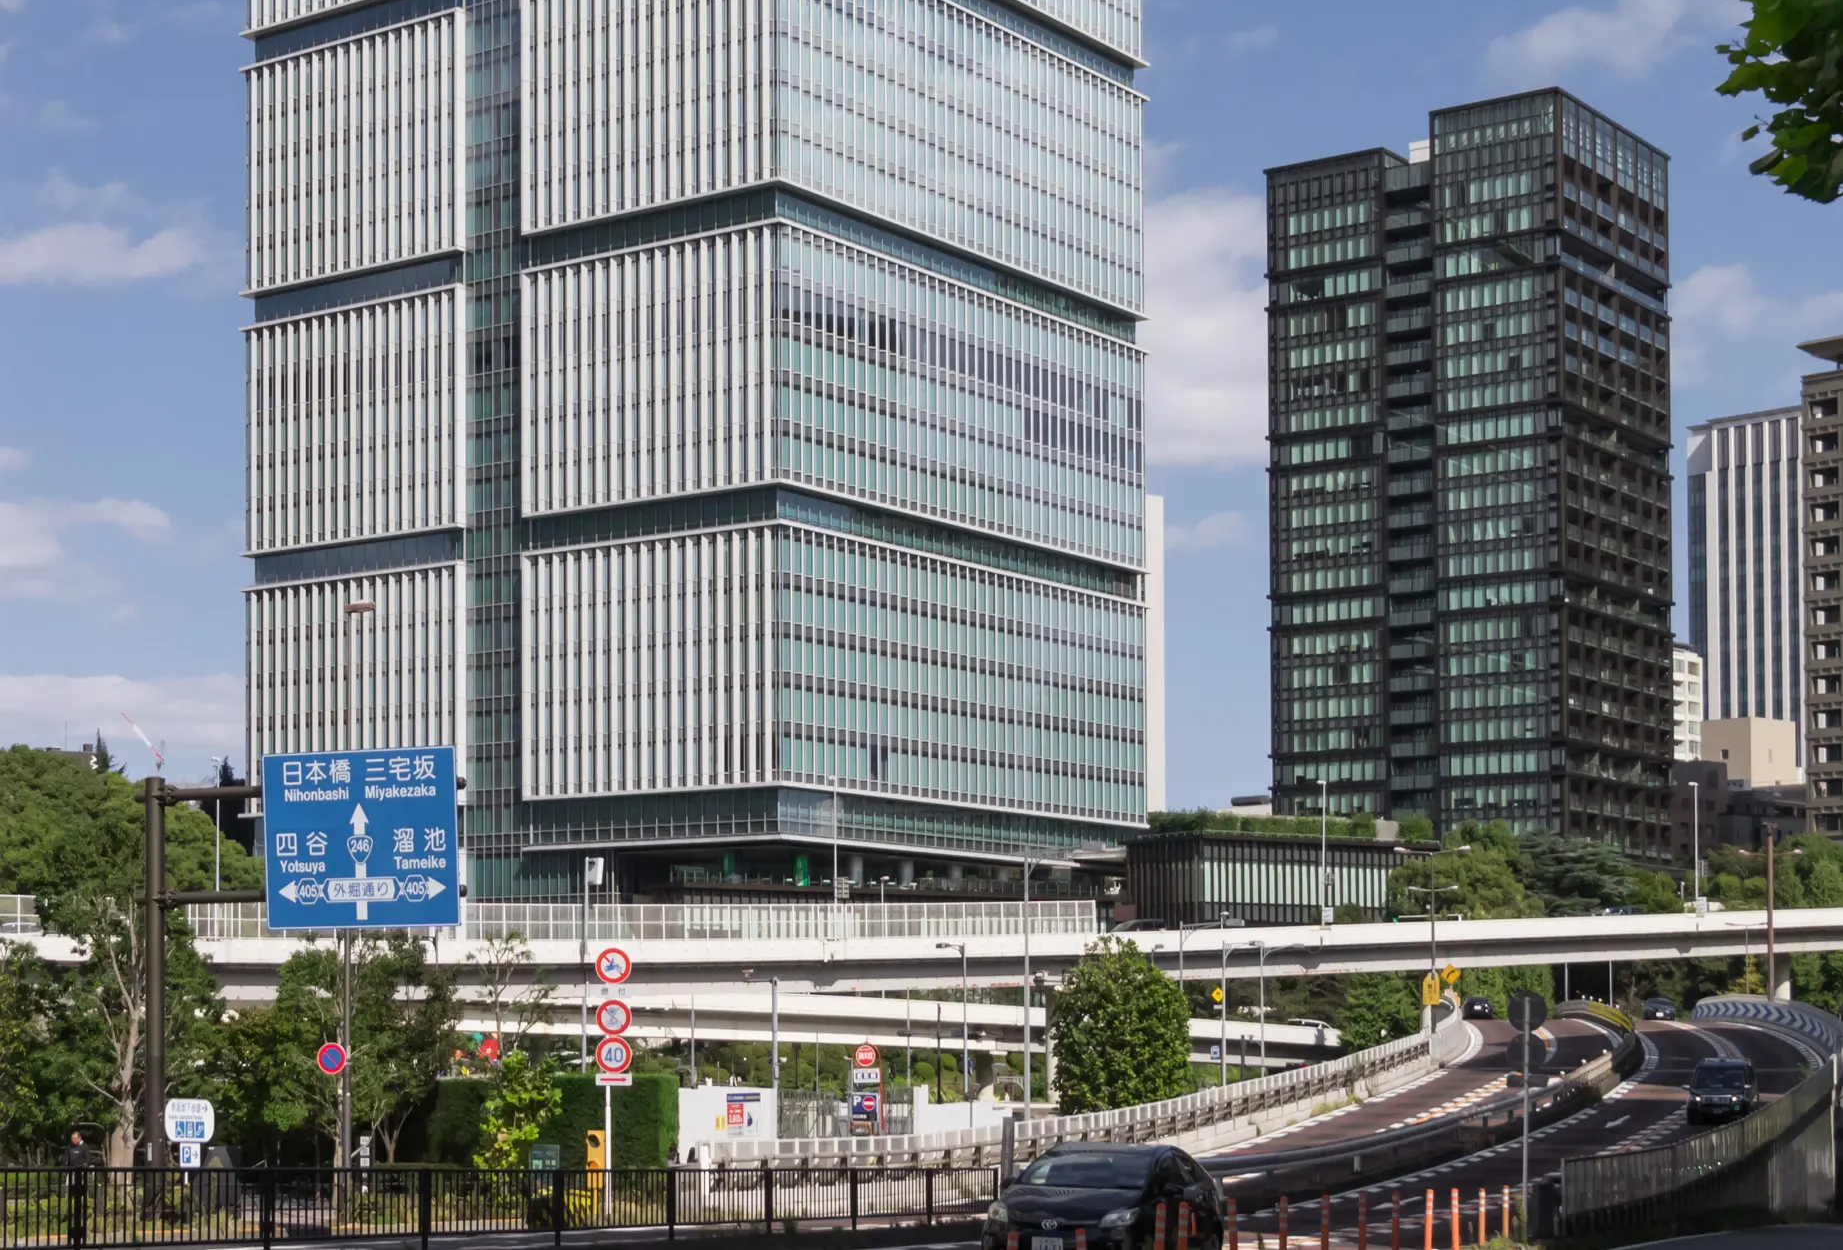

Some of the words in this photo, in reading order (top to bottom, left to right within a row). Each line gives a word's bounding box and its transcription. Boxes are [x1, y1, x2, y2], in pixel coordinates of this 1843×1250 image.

[283, 759, 351, 785] 日本橋
[365, 755, 436, 781] 三宅坂
[284, 787, 349, 802] Nihonbashi
[365, 784, 436, 801] Miyakezaka
[276, 831, 328, 856] 四谷
[351, 839, 369, 852] 246
[393, 827, 446, 852] 溜池
[280, 860, 326, 875] Yotsuya
[394, 855, 446, 869] Tameike
[300, 884, 317, 897] 405
[334, 882, 388, 897] 外堀通り
[406, 882, 425, 894] 405
[604, 1047, 624, 1062] 40
[853, 1096, 861, 1106] P
[184, 1147, 190, 1162] P
